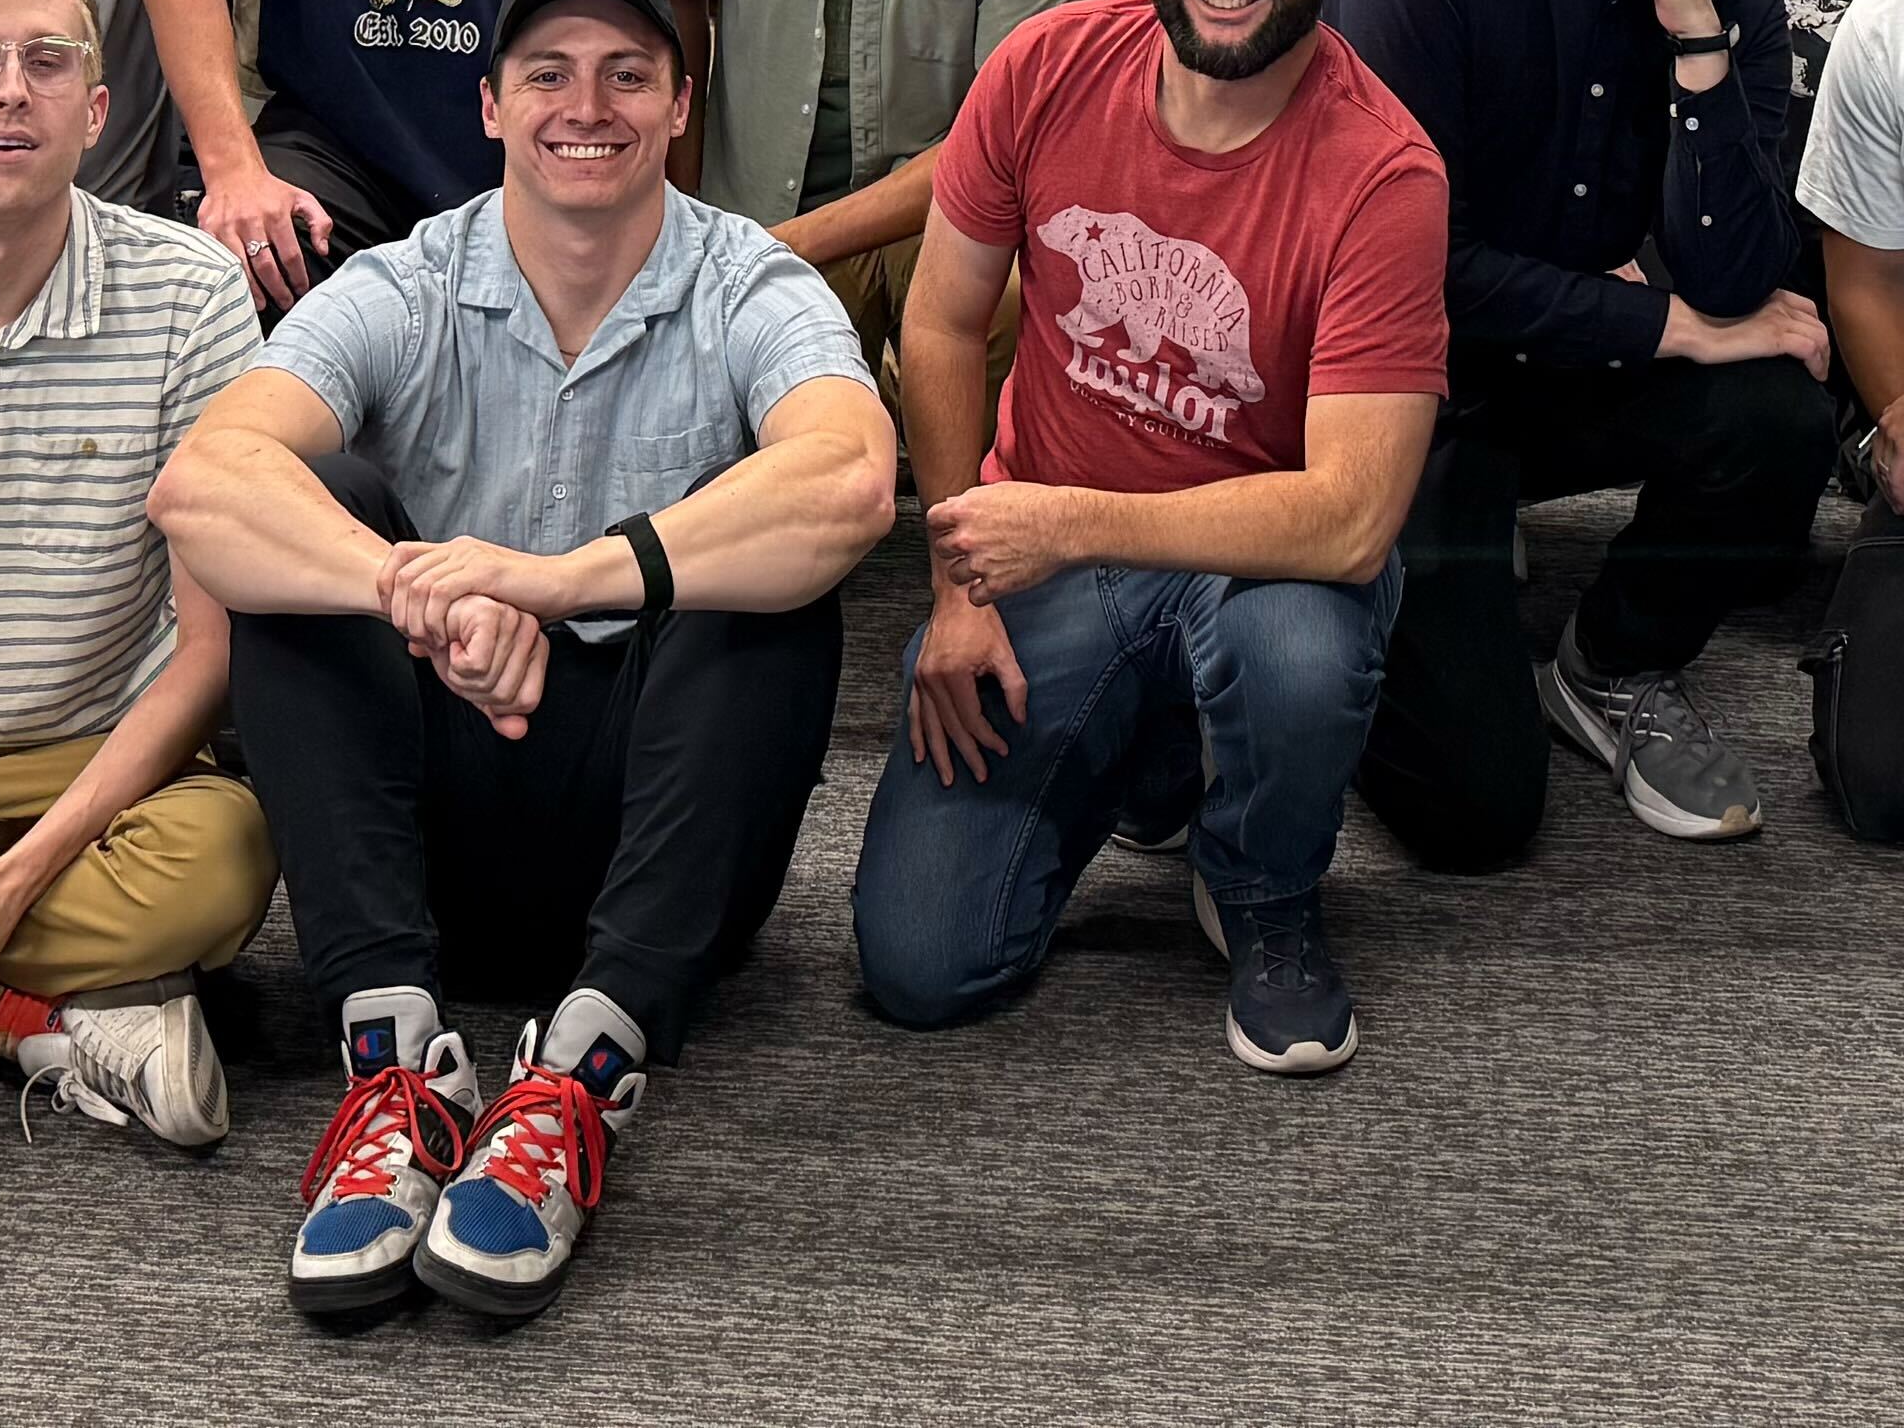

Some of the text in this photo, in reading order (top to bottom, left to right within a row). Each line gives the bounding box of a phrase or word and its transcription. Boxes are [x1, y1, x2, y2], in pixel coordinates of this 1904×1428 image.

[408, 16, 481, 55] 2010
[1082, 238, 1245, 333] CALIFORNIA
[1114, 276, 1194, 319] BORN &
[1154, 306, 1229, 352] RAISED
